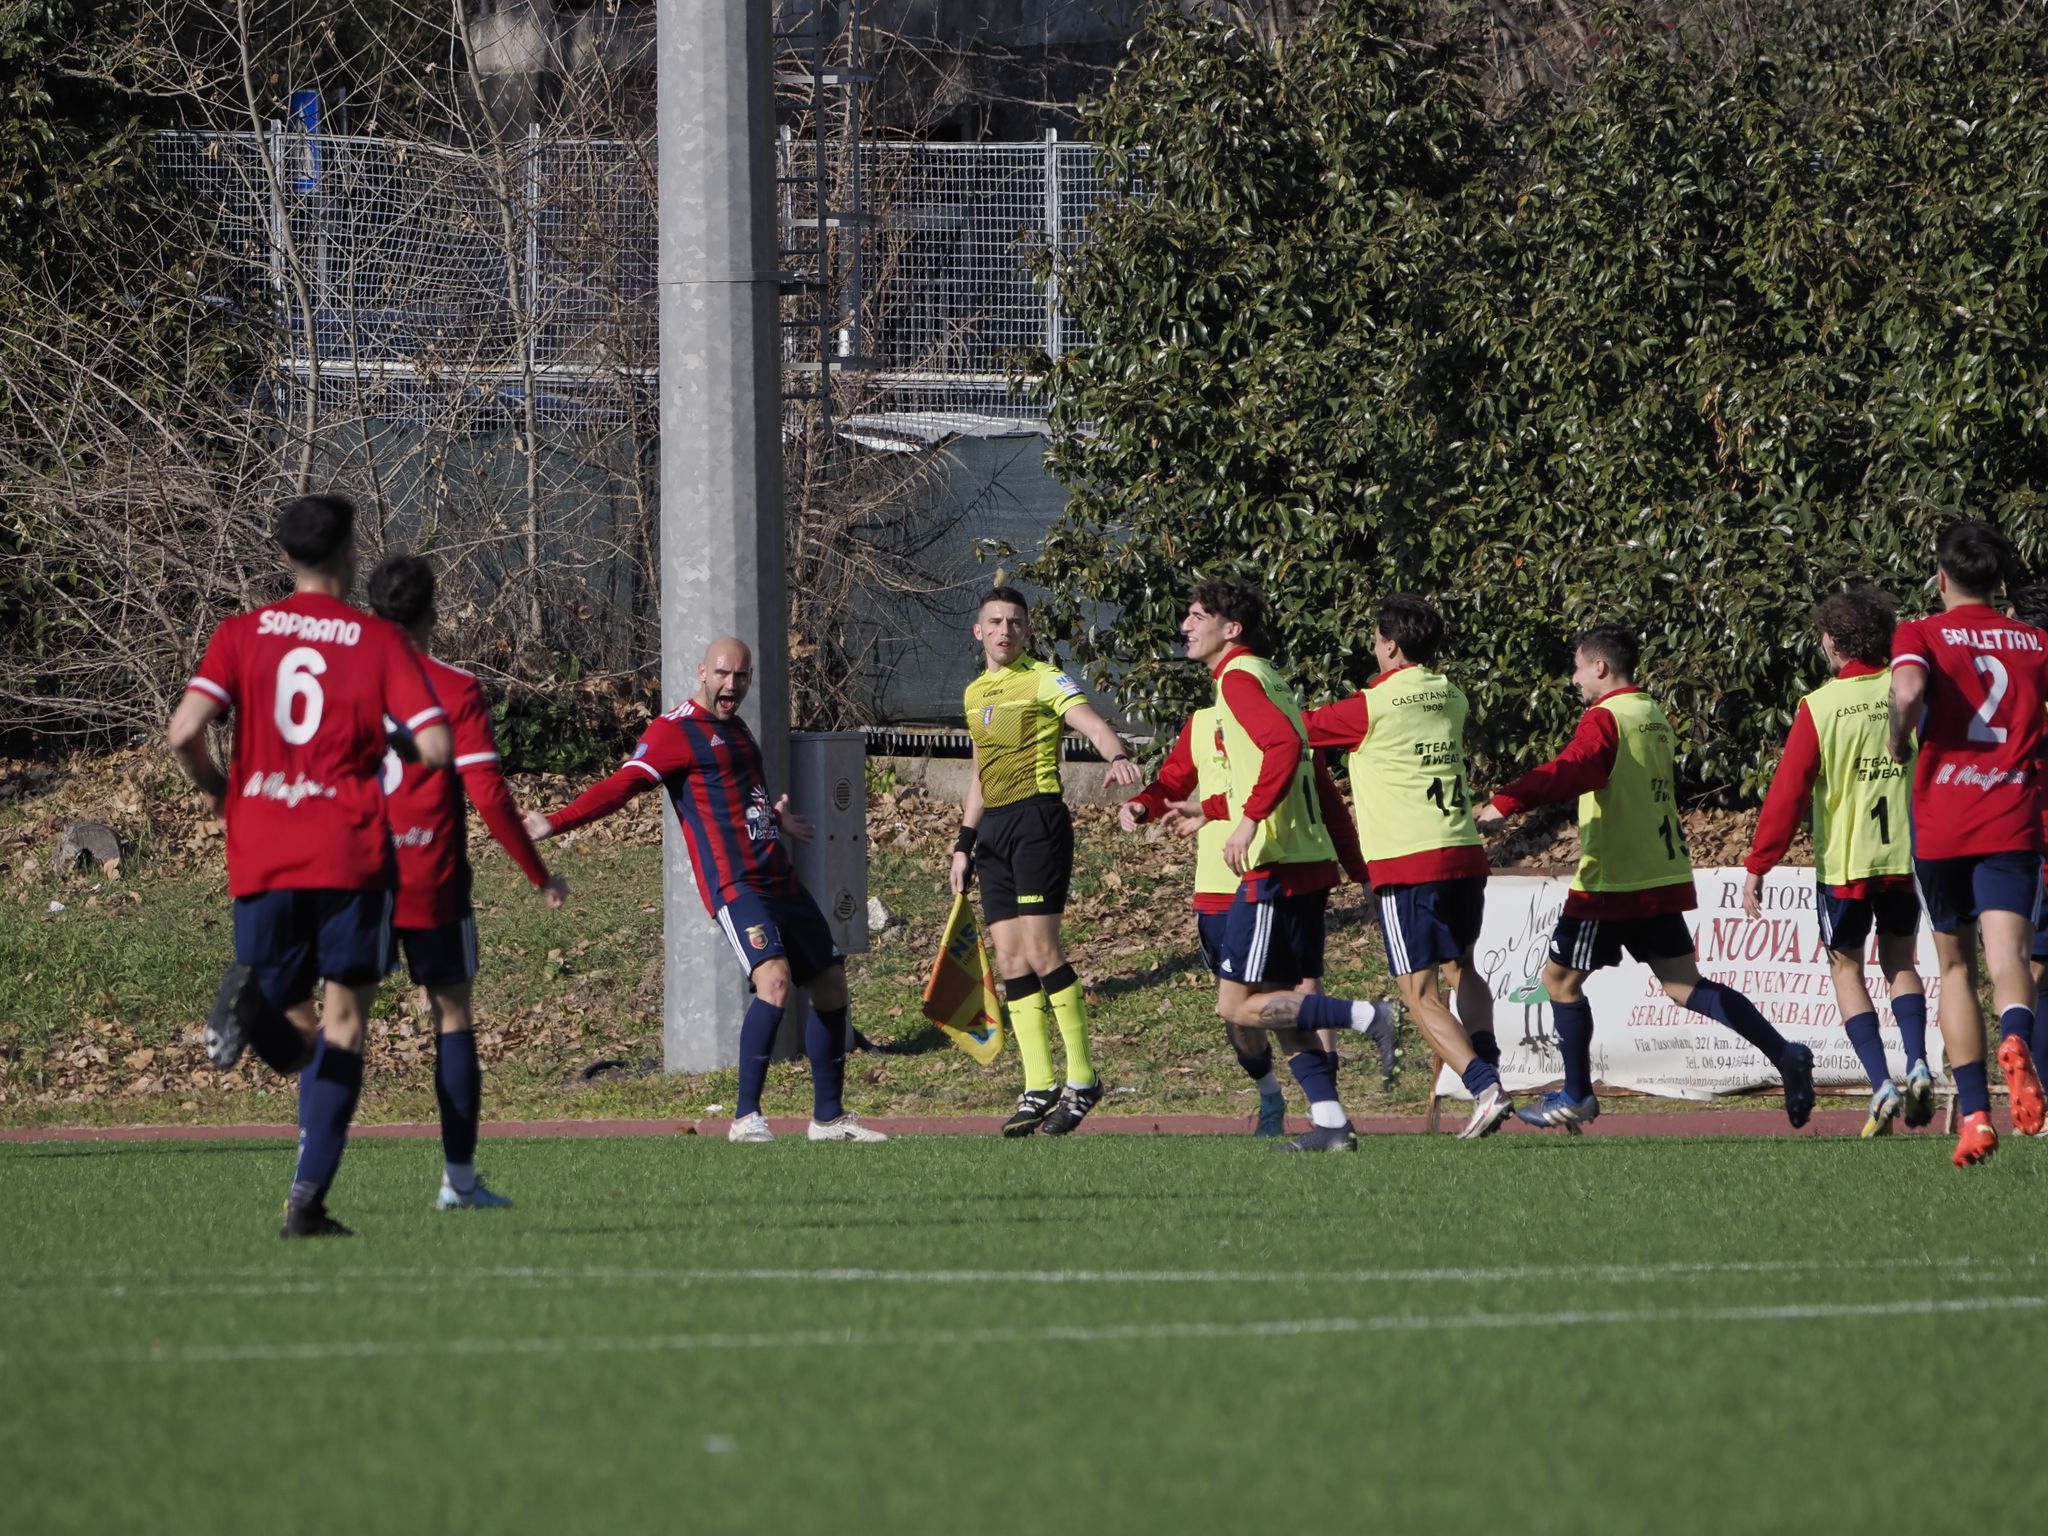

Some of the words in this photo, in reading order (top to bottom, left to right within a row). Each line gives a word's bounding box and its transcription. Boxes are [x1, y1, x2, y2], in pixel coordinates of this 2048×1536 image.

[257, 610, 362, 646] SOPRANO
[274, 646, 327, 745] 6
[1967, 654, 2007, 744] 2
[1707, 917, 1803, 963] NUOVA
[1742, 970, 1812, 994] EVENTI
[1769, 1001, 1837, 1027] SABATO
